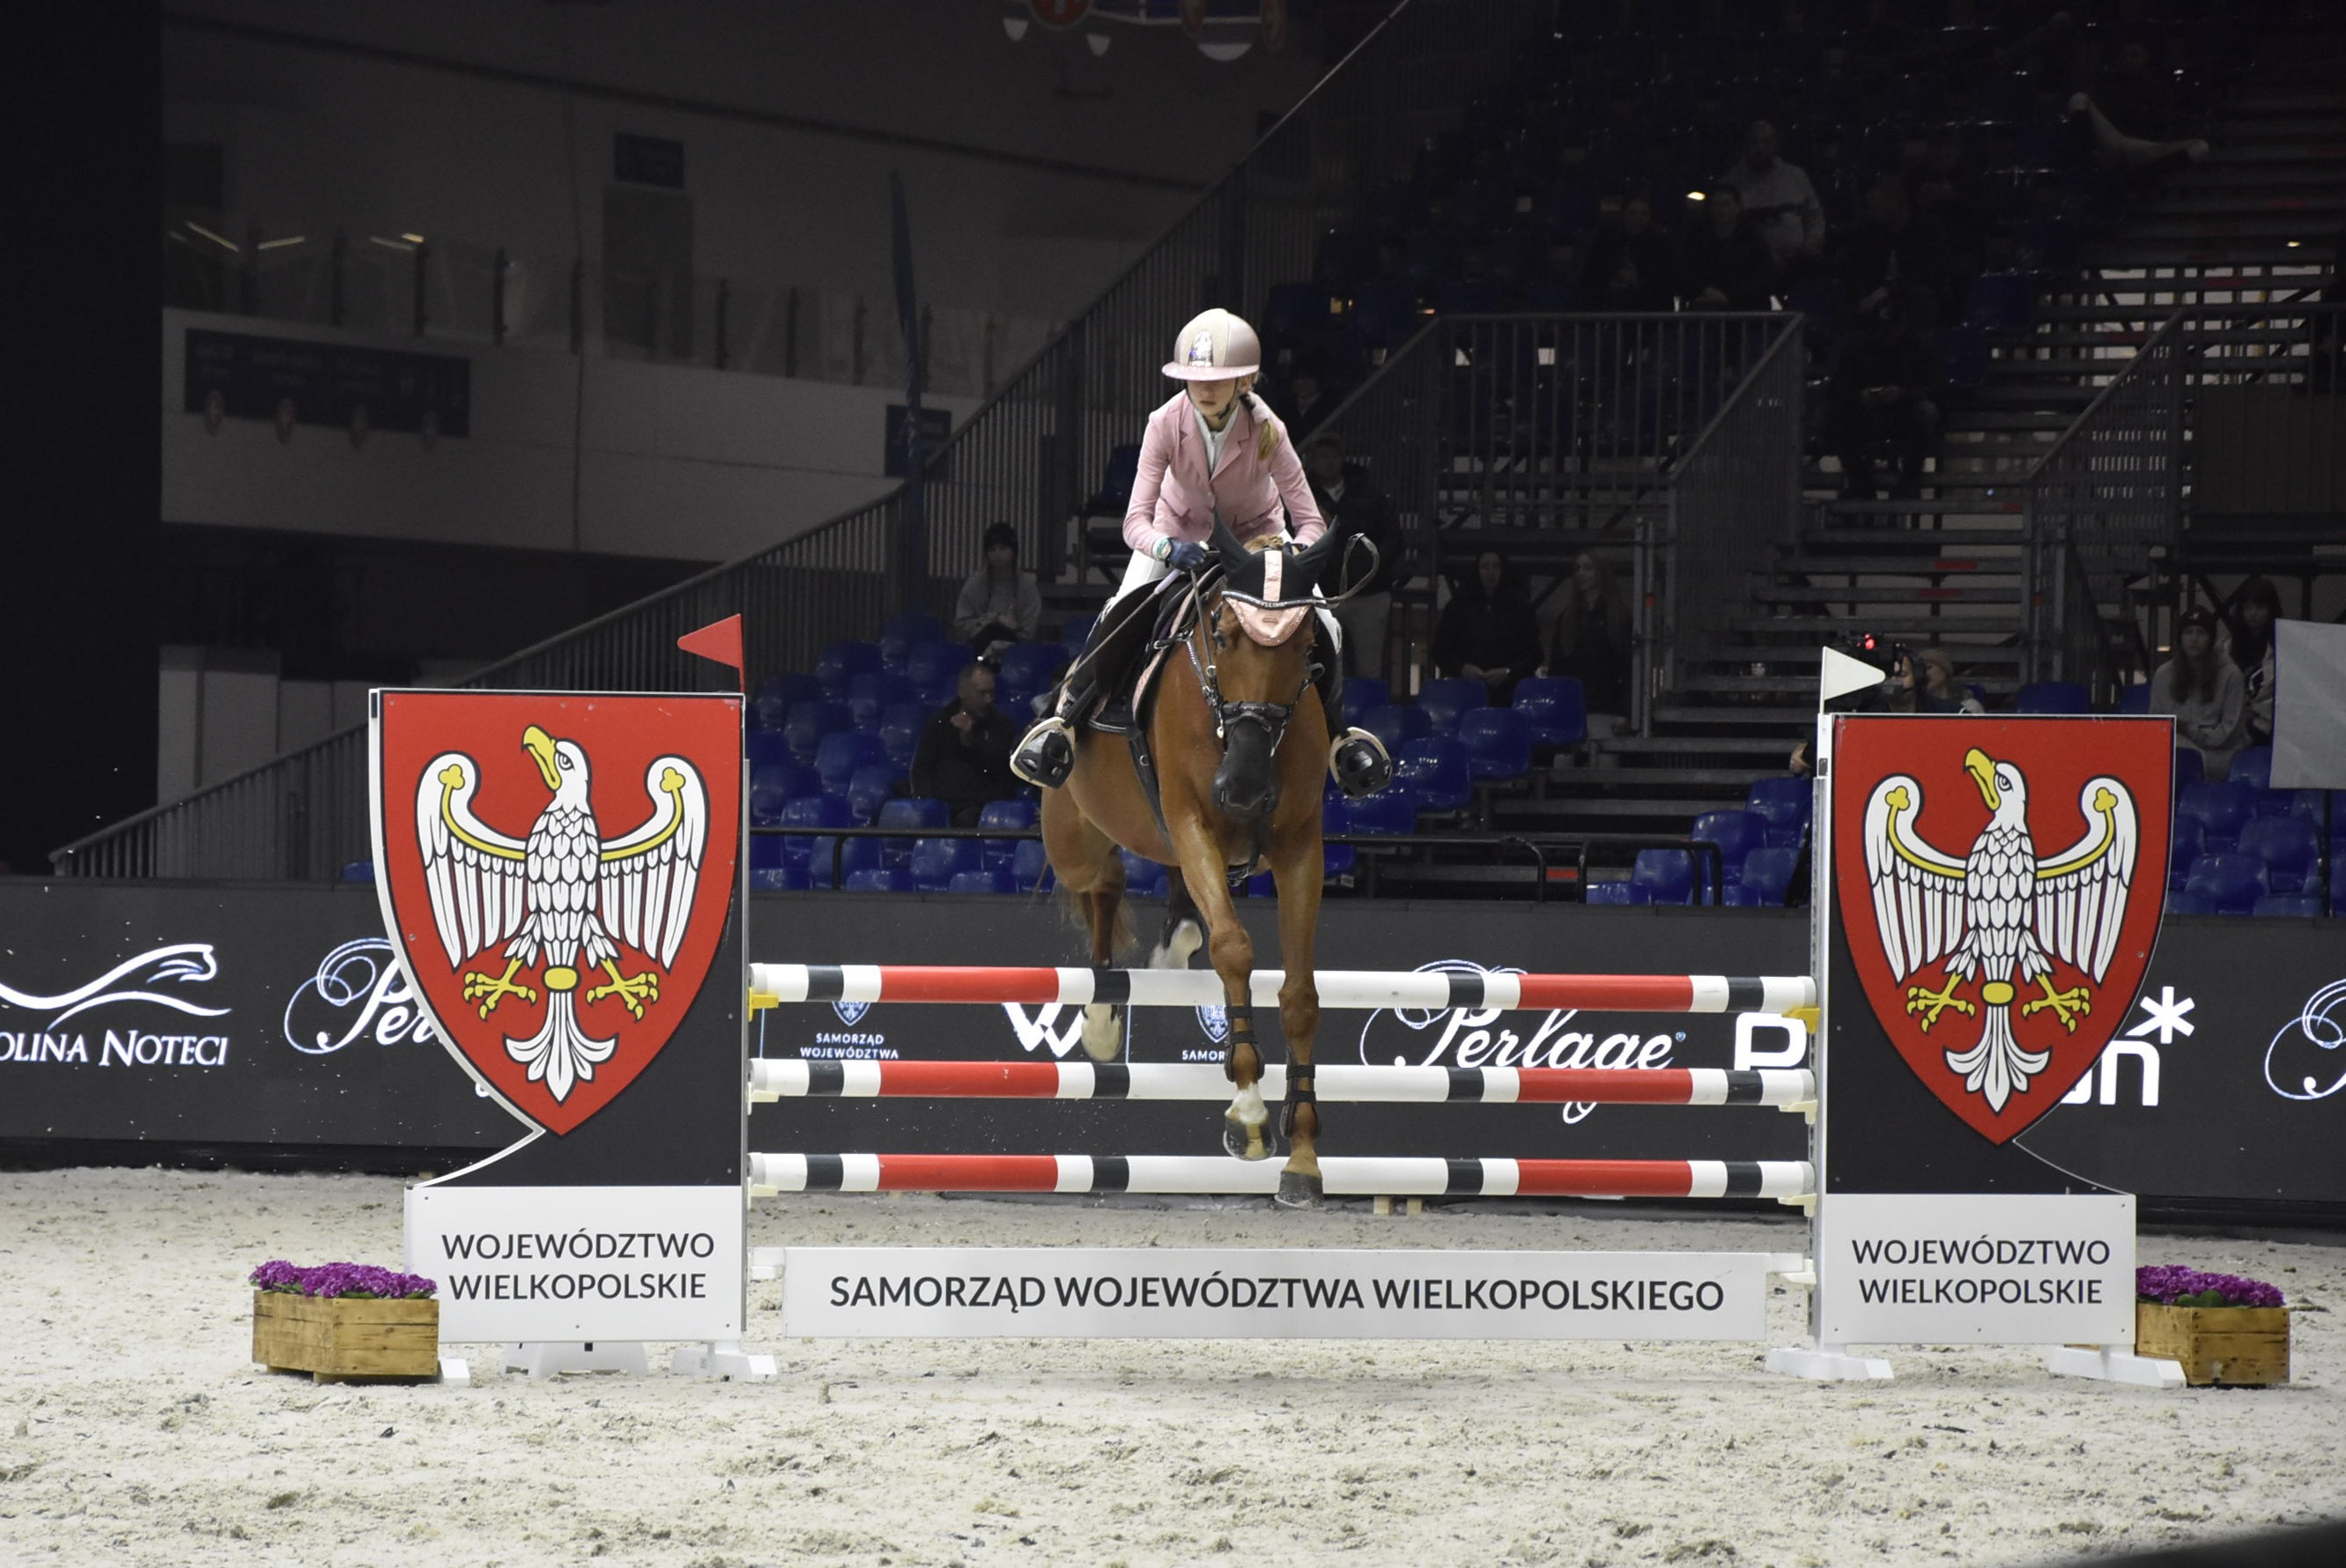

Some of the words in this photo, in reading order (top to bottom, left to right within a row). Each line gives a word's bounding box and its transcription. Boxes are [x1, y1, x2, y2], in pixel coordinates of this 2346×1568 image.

[98, 1029, 229, 1067] NOTECI
[799, 1046, 899, 1060] WOJEWÓDZTWA
[815, 1032, 884, 1047] SAMORZĄD
[1181, 1049, 1226, 1061] SAMOR
[441, 1227, 715, 1261] WOJEWÓDZTWO
[1851, 1234, 2111, 1265] WOJEWÓDZTWO
[448, 1273, 707, 1301] WIELKOPOLSKIE
[829, 1276, 1047, 1313] SAMORZĄD
[1054, 1270, 1365, 1308] WOJEWÓDZTWA
[1372, 1278, 1725, 1311] WIELKOPOLSKIEGO
[1858, 1278, 2103, 1305] WIELKOPOLSKIE
